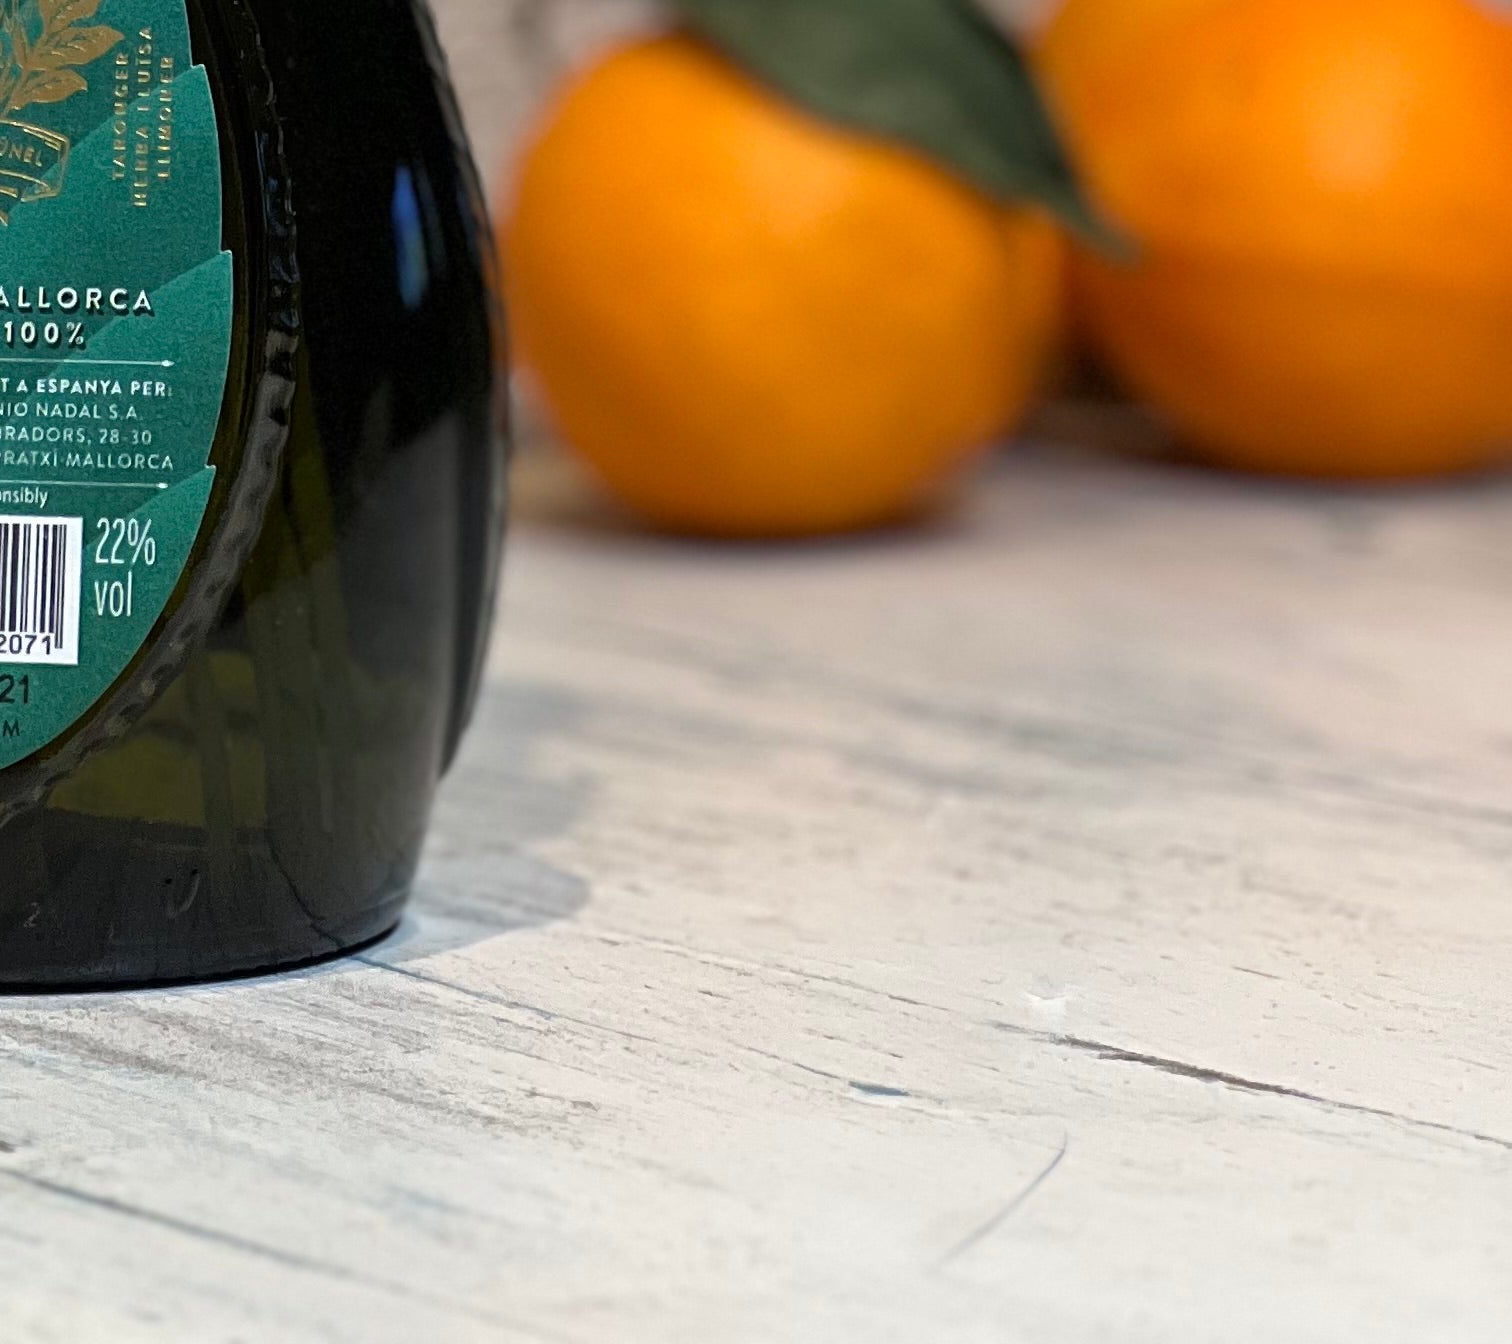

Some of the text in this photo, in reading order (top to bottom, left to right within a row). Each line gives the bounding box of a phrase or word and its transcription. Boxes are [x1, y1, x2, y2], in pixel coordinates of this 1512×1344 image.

[112, 51, 129, 180] TARONGER
[157, 56, 174, 178] LLIMONER
[133, 125, 149, 207] HERBA
[3, 321, 85, 346] 100%
[16, 379, 28, 393] A
[37, 378, 123, 395] ESPANYA
[36, 402, 102, 419] NADAL
[95, 516, 156, 566] 22%
[94, 570, 133, 617] vol
